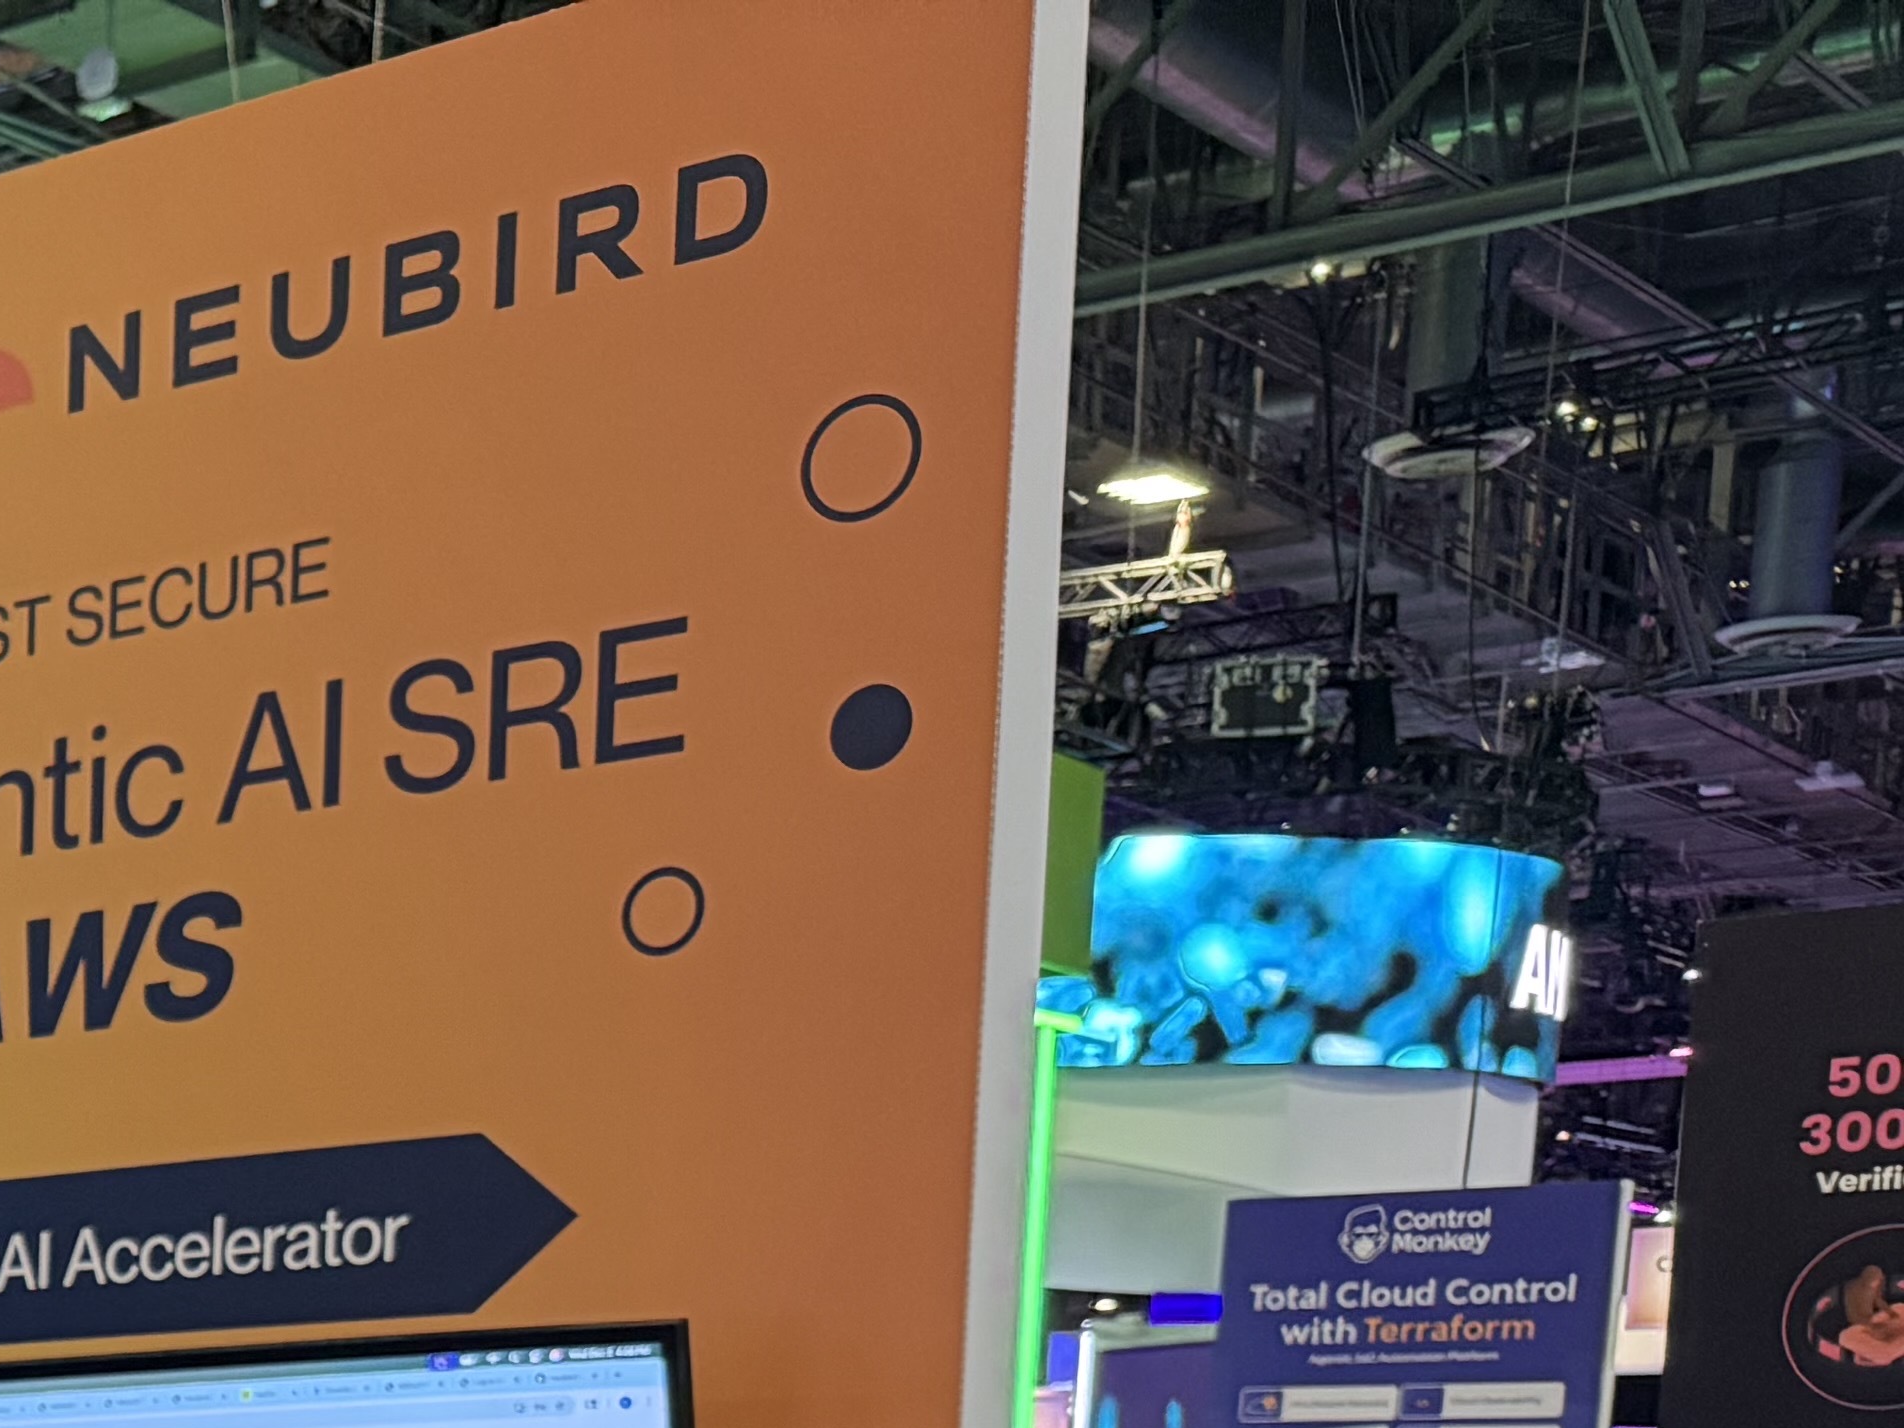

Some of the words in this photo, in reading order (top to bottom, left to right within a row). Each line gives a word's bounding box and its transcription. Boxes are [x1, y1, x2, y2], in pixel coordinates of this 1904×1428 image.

[65, 151, 770, 415] NEUBIRD
[66, 536, 332, 647] SECURE
[216, 677, 346, 824] AI
[383, 615, 689, 796] SRE
[1816, 1166, 1904, 1195] Verifi
[1393, 1206, 1492, 1233] Control
[62, 1202, 411, 1290] Accelerator
[1391, 1228, 1492, 1257] Monkey
[1249, 1280, 1329, 1313] Total
[1335, 1276, 1437, 1310] Cloud
[1444, 1272, 1579, 1306] Control
[1279, 1315, 1357, 1347] with
[1362, 1312, 1537, 1345] Terraform
